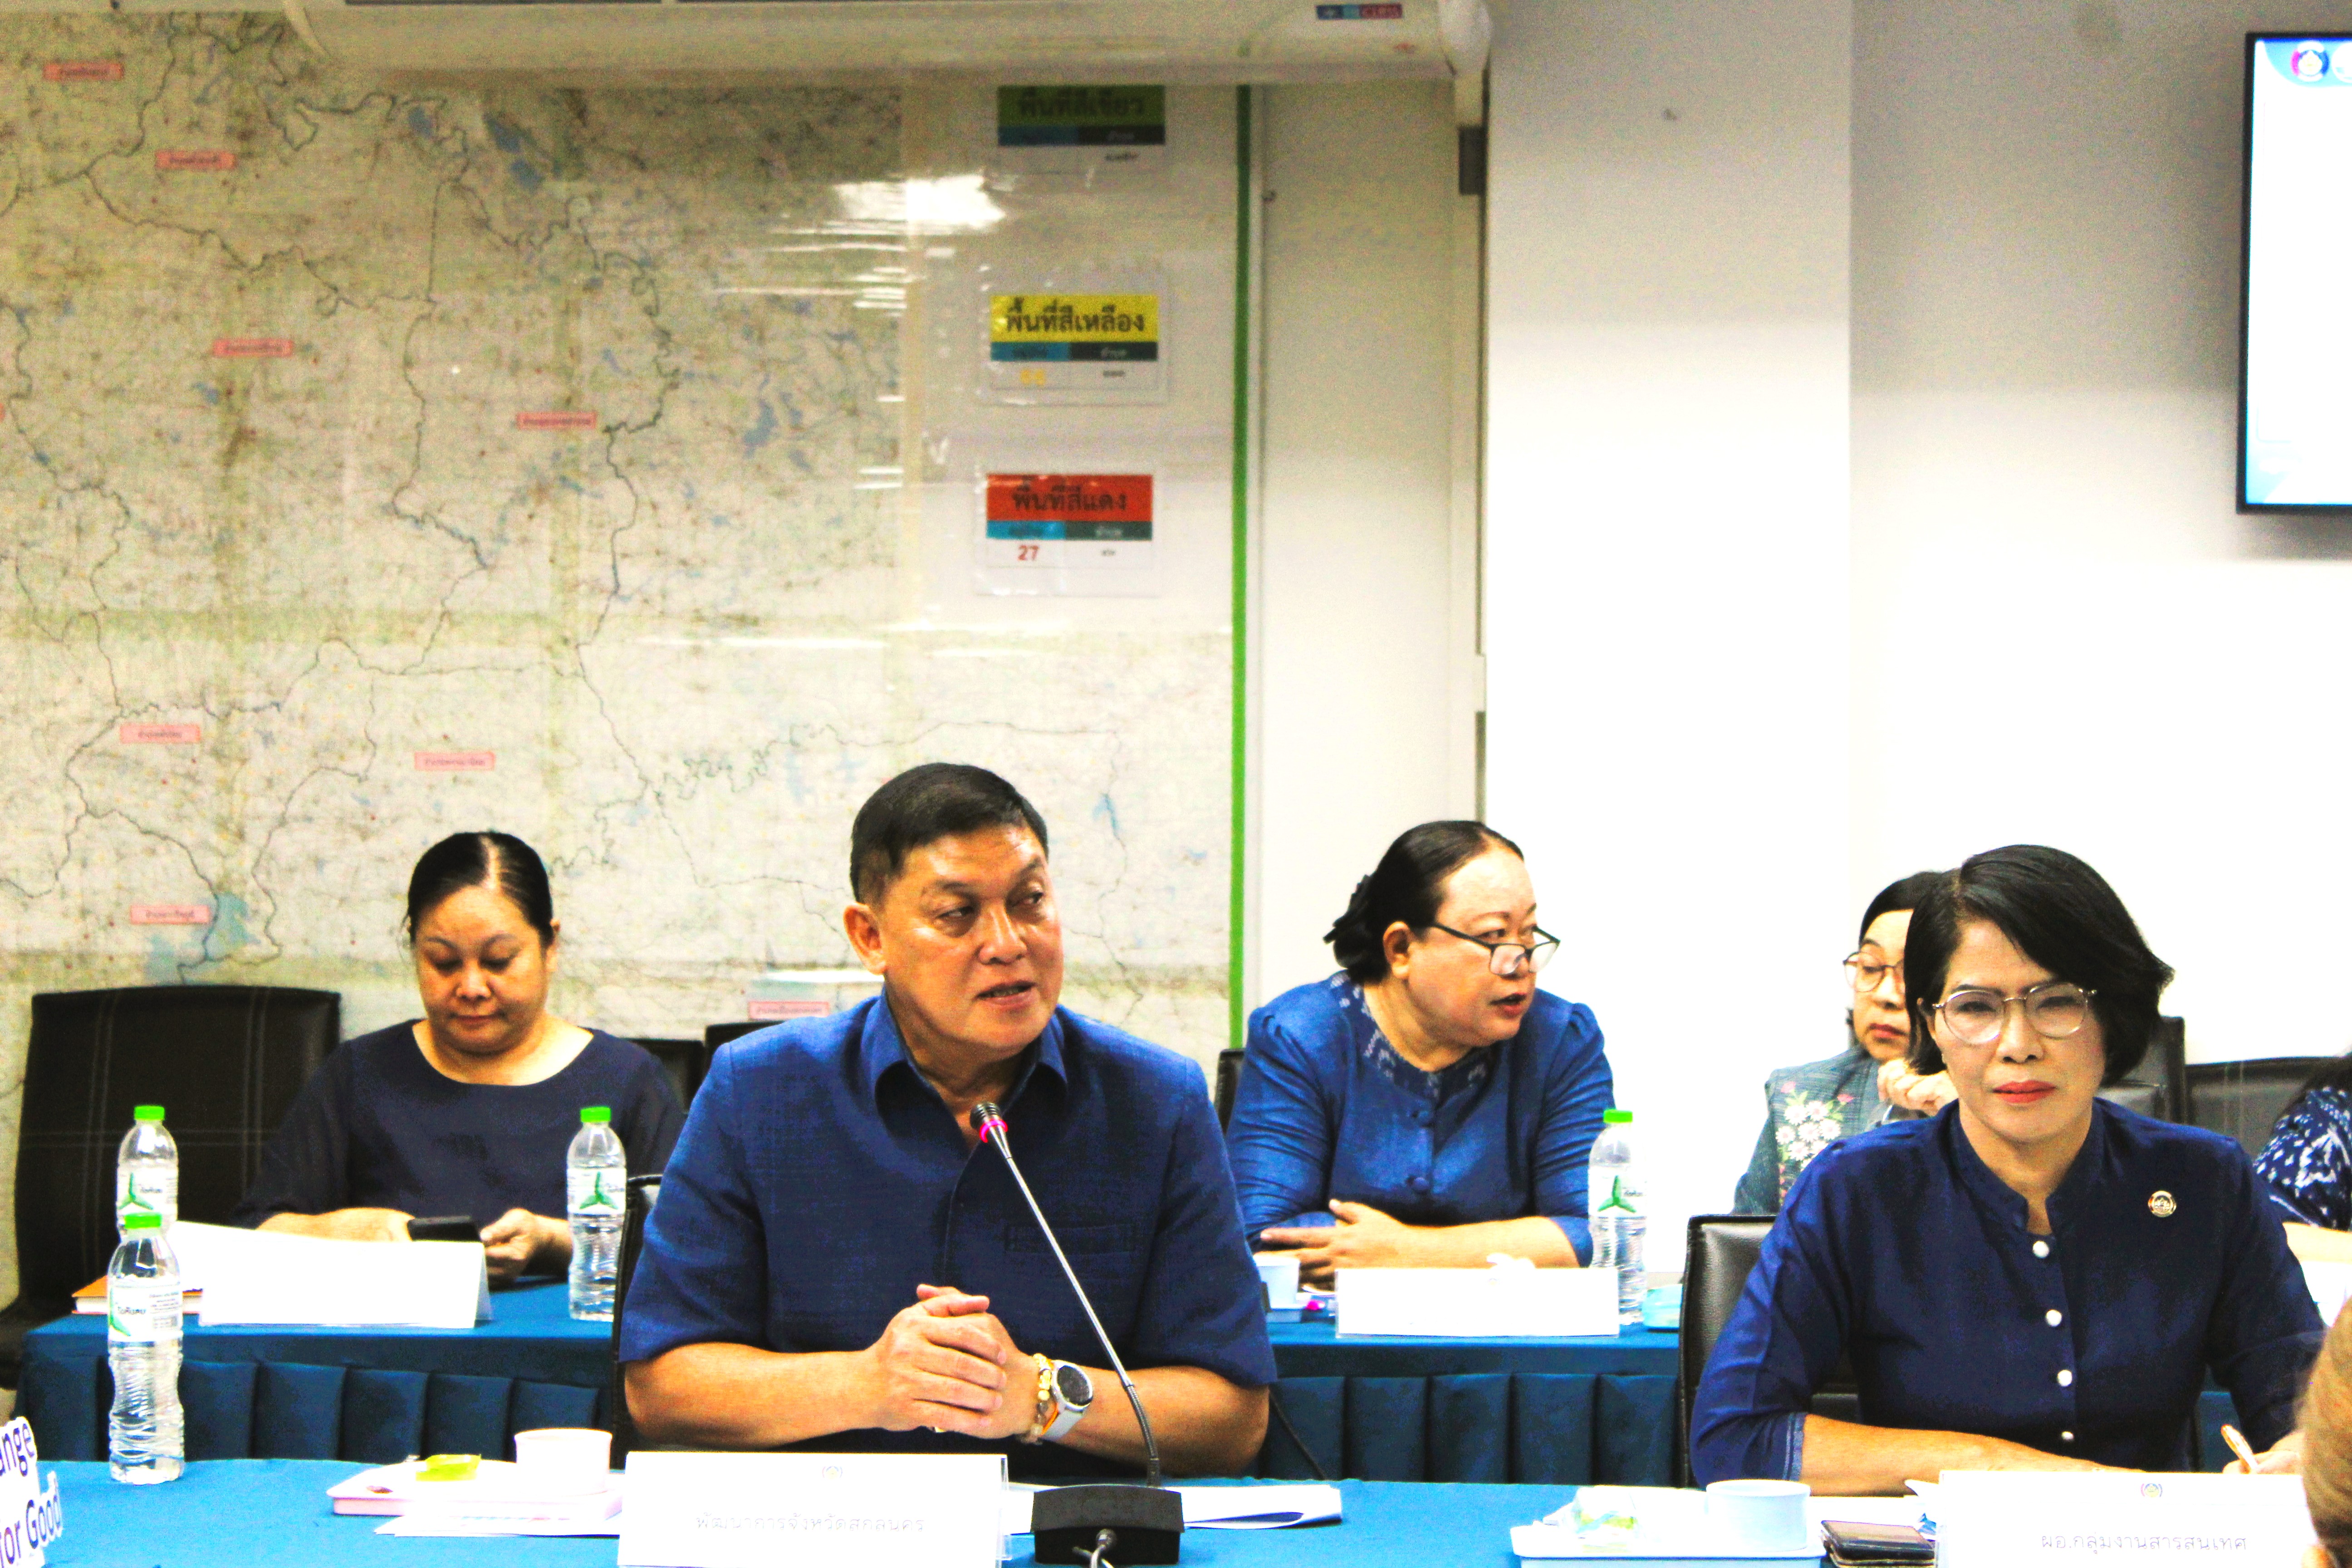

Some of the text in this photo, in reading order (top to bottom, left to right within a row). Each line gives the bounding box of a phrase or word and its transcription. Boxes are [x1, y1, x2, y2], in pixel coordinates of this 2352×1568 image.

[1006, 297, 1145, 332] พื้นที่สีเหลือง
[1018, 545, 1039, 561] 27
[26, 1478, 61, 1549] Good
[696, 1512, 925, 1532] พัฒนาการจังหวัดสกลนคร
[2041, 1532, 2247, 1555] ผอ.กลุ่มงานสารสนเทศ
